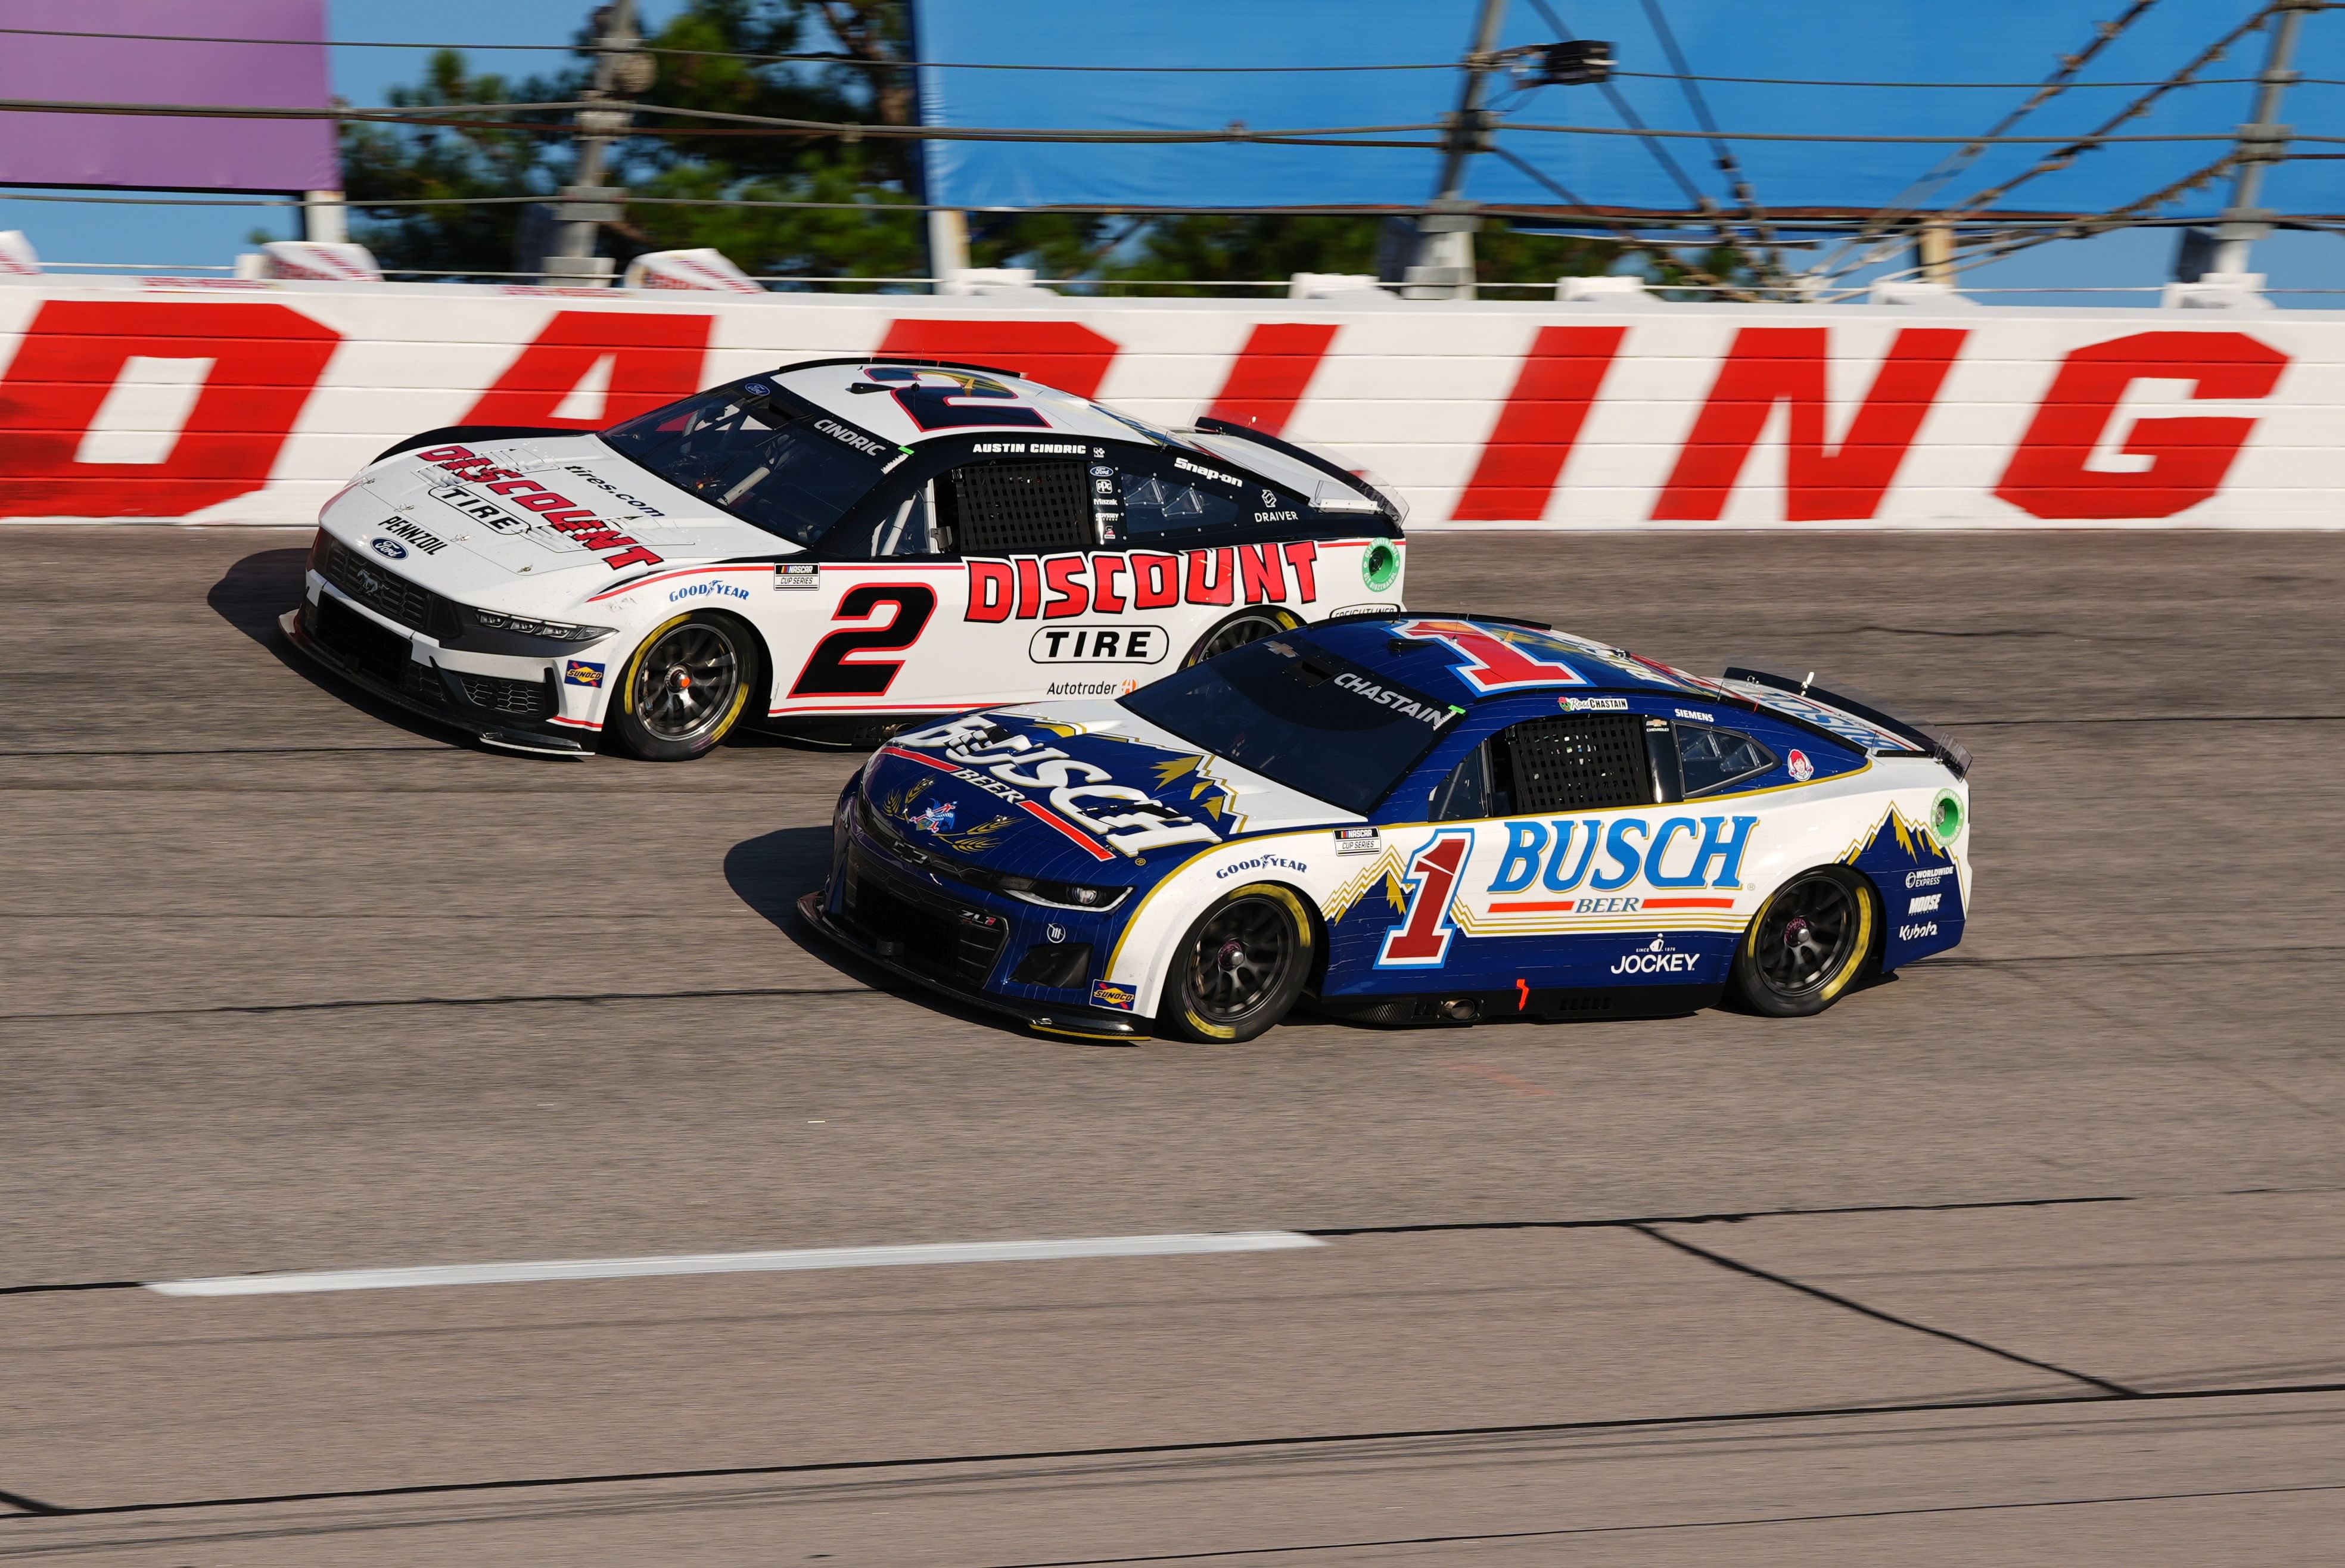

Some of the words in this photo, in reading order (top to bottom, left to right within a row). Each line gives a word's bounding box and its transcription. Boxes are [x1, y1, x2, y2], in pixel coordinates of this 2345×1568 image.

[747, 384, 768, 395] Ford
[864, 368, 1053, 433] 2
[814, 419, 886, 457] CINDRIC
[973, 443, 1025, 453] AUSTIN
[1030, 444, 1086, 454] CINDRIC
[1093, 467, 1111, 475] Ford
[1174, 458, 1243, 488] Snap-on
[564, 465, 666, 517] tires.com
[418, 445, 664, 570] DISCOUNT
[441, 488, 520, 530] TIRE
[1254, 511, 1298, 522] DRAIVER
[378, 516, 448, 555] PENNZOIL
[374, 539, 408, 559] Ford
[789, 565, 814, 574] NASCAR
[669, 580, 749, 602] GOODYEAR
[963, 541, 1318, 624] DISCOUNT
[786, 582, 937, 699] 2
[1046, 631, 1151, 658] TIRE
[1388, 620, 1592, 694] 1
[568, 669, 602, 680] SUNOCO
[1047, 680, 1118, 695] Autotrader
[1333, 672, 1448, 724] CHASTAIN
[1675, 708, 1715, 723] SIEMENS
[894, 715, 1223, 858] BUSCH
[951, 767, 1027, 804] BEER
[1348, 829, 1373, 839] NASCAR
[1354, 840, 1374, 848] SERIES
[1488, 815, 1759, 894] BUSCH
[1216, 854, 1307, 879] GOODYEAR
[1916, 866, 1954, 879] WORLDWIDE
[1915, 876, 1941, 887] EXPRESS
[1377, 832, 1472, 966] 1
[1573, 897, 1641, 914] BEER
[1908, 894, 1942, 914] MOOSE
[1899, 921, 1938, 941] Kubota
[1610, 954, 1700, 974] JOCKEY
[1094, 990, 1134, 1002] SUNOCO
